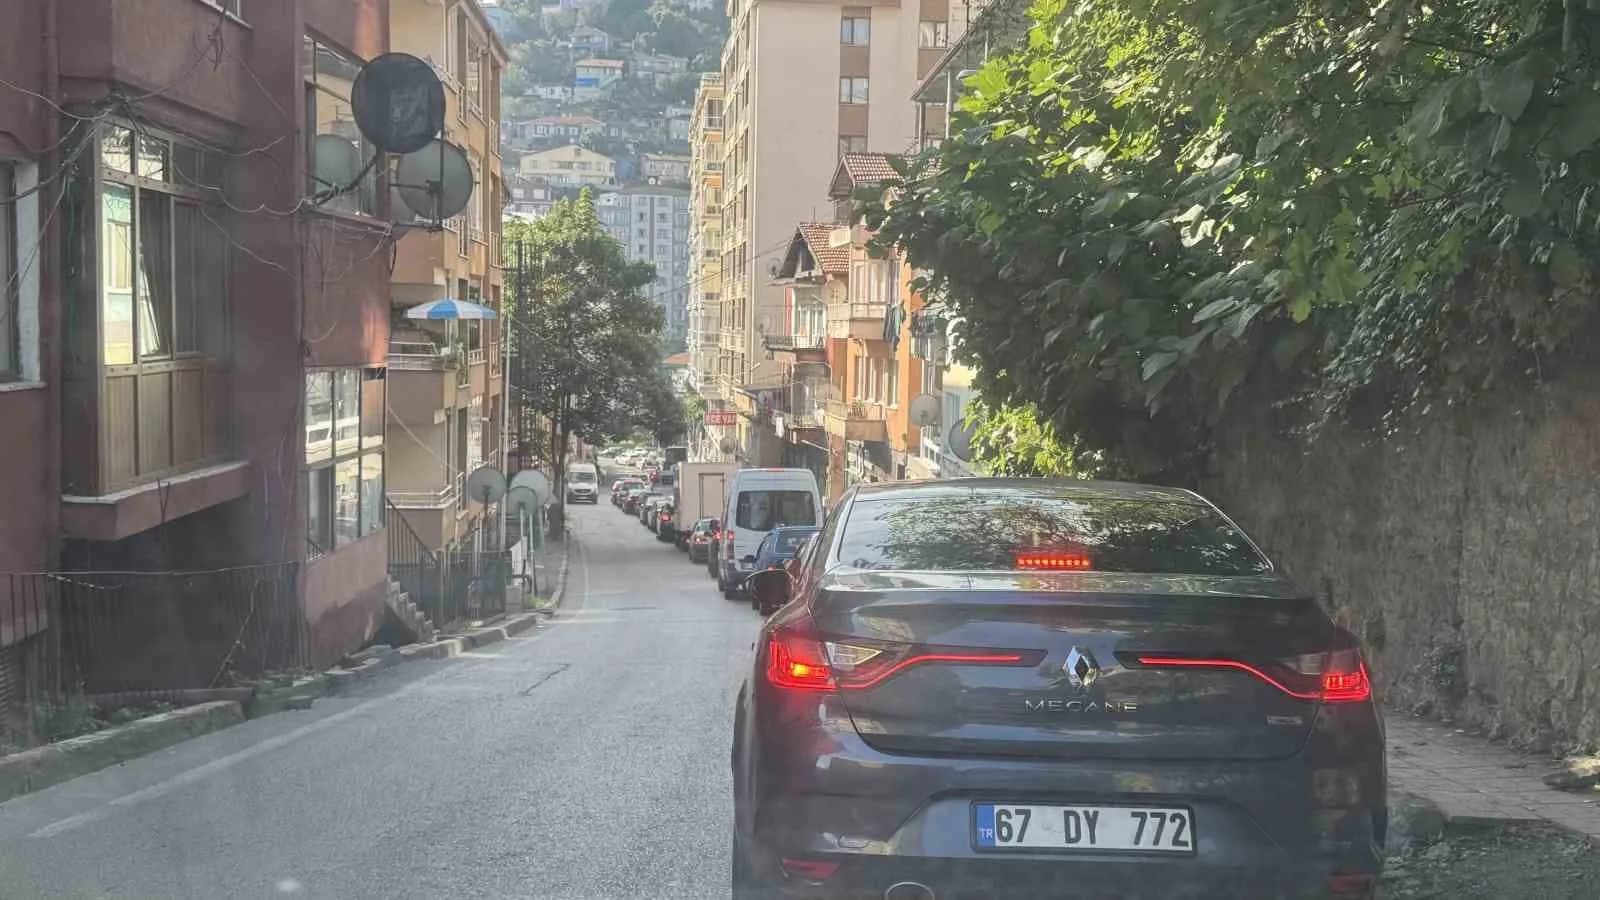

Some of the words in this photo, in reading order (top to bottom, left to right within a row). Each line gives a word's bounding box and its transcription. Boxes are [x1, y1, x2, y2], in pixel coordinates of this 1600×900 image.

[979, 827, 993, 840] TR
[995, 808, 1032, 843] 67
[1063, 809, 1100, 845] DY
[1130, 811, 1190, 848] 772
